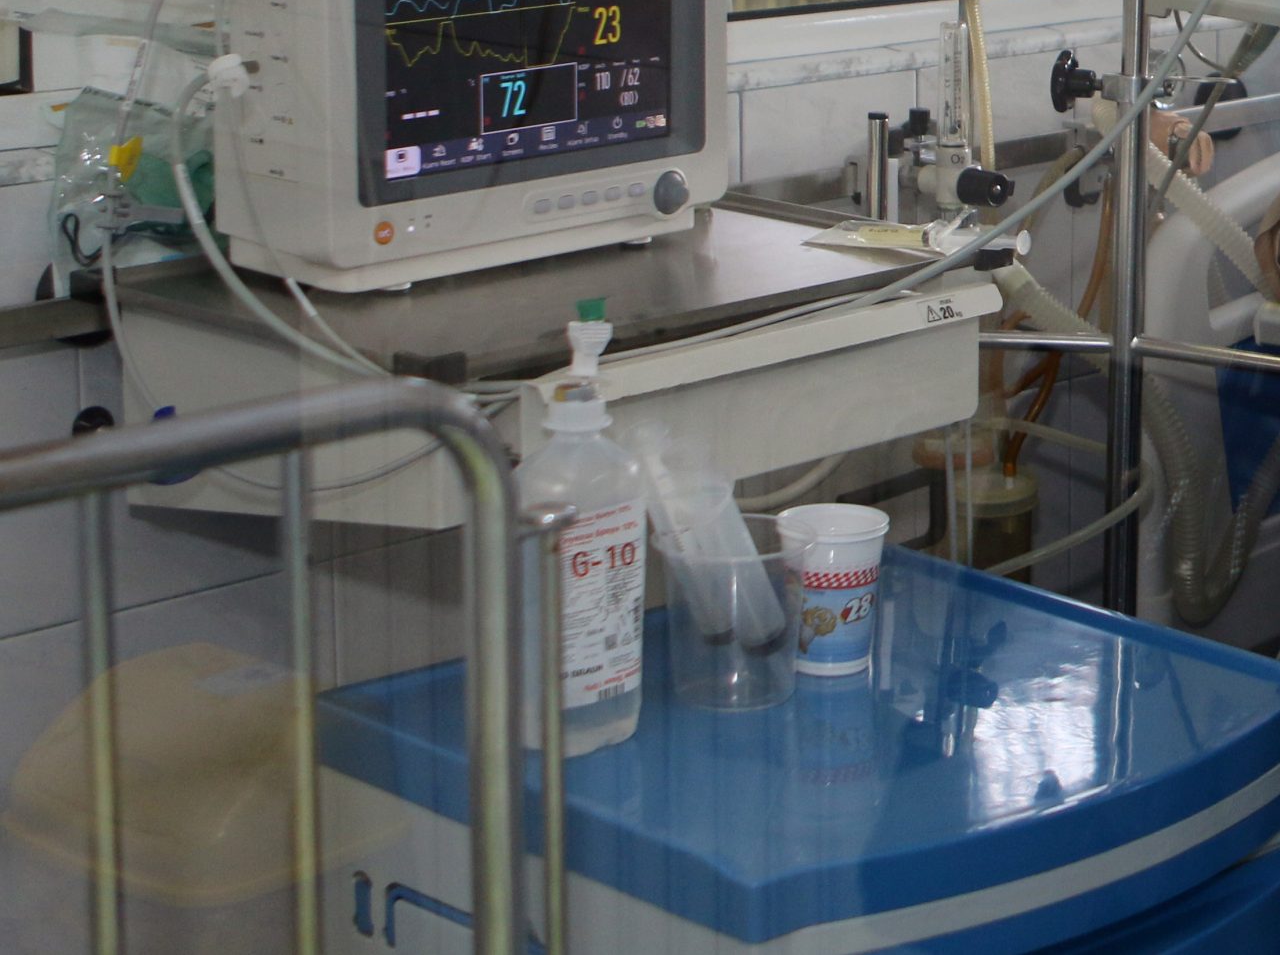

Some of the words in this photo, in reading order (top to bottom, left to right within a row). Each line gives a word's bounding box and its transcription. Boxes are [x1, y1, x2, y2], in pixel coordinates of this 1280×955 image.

[593, 5, 622, 46] 23
[499, 79, 527, 119] 72
[939, 305, 955, 320] 20
[570, 542, 637, 579] G-10
[844, 593, 873, 625] 28
